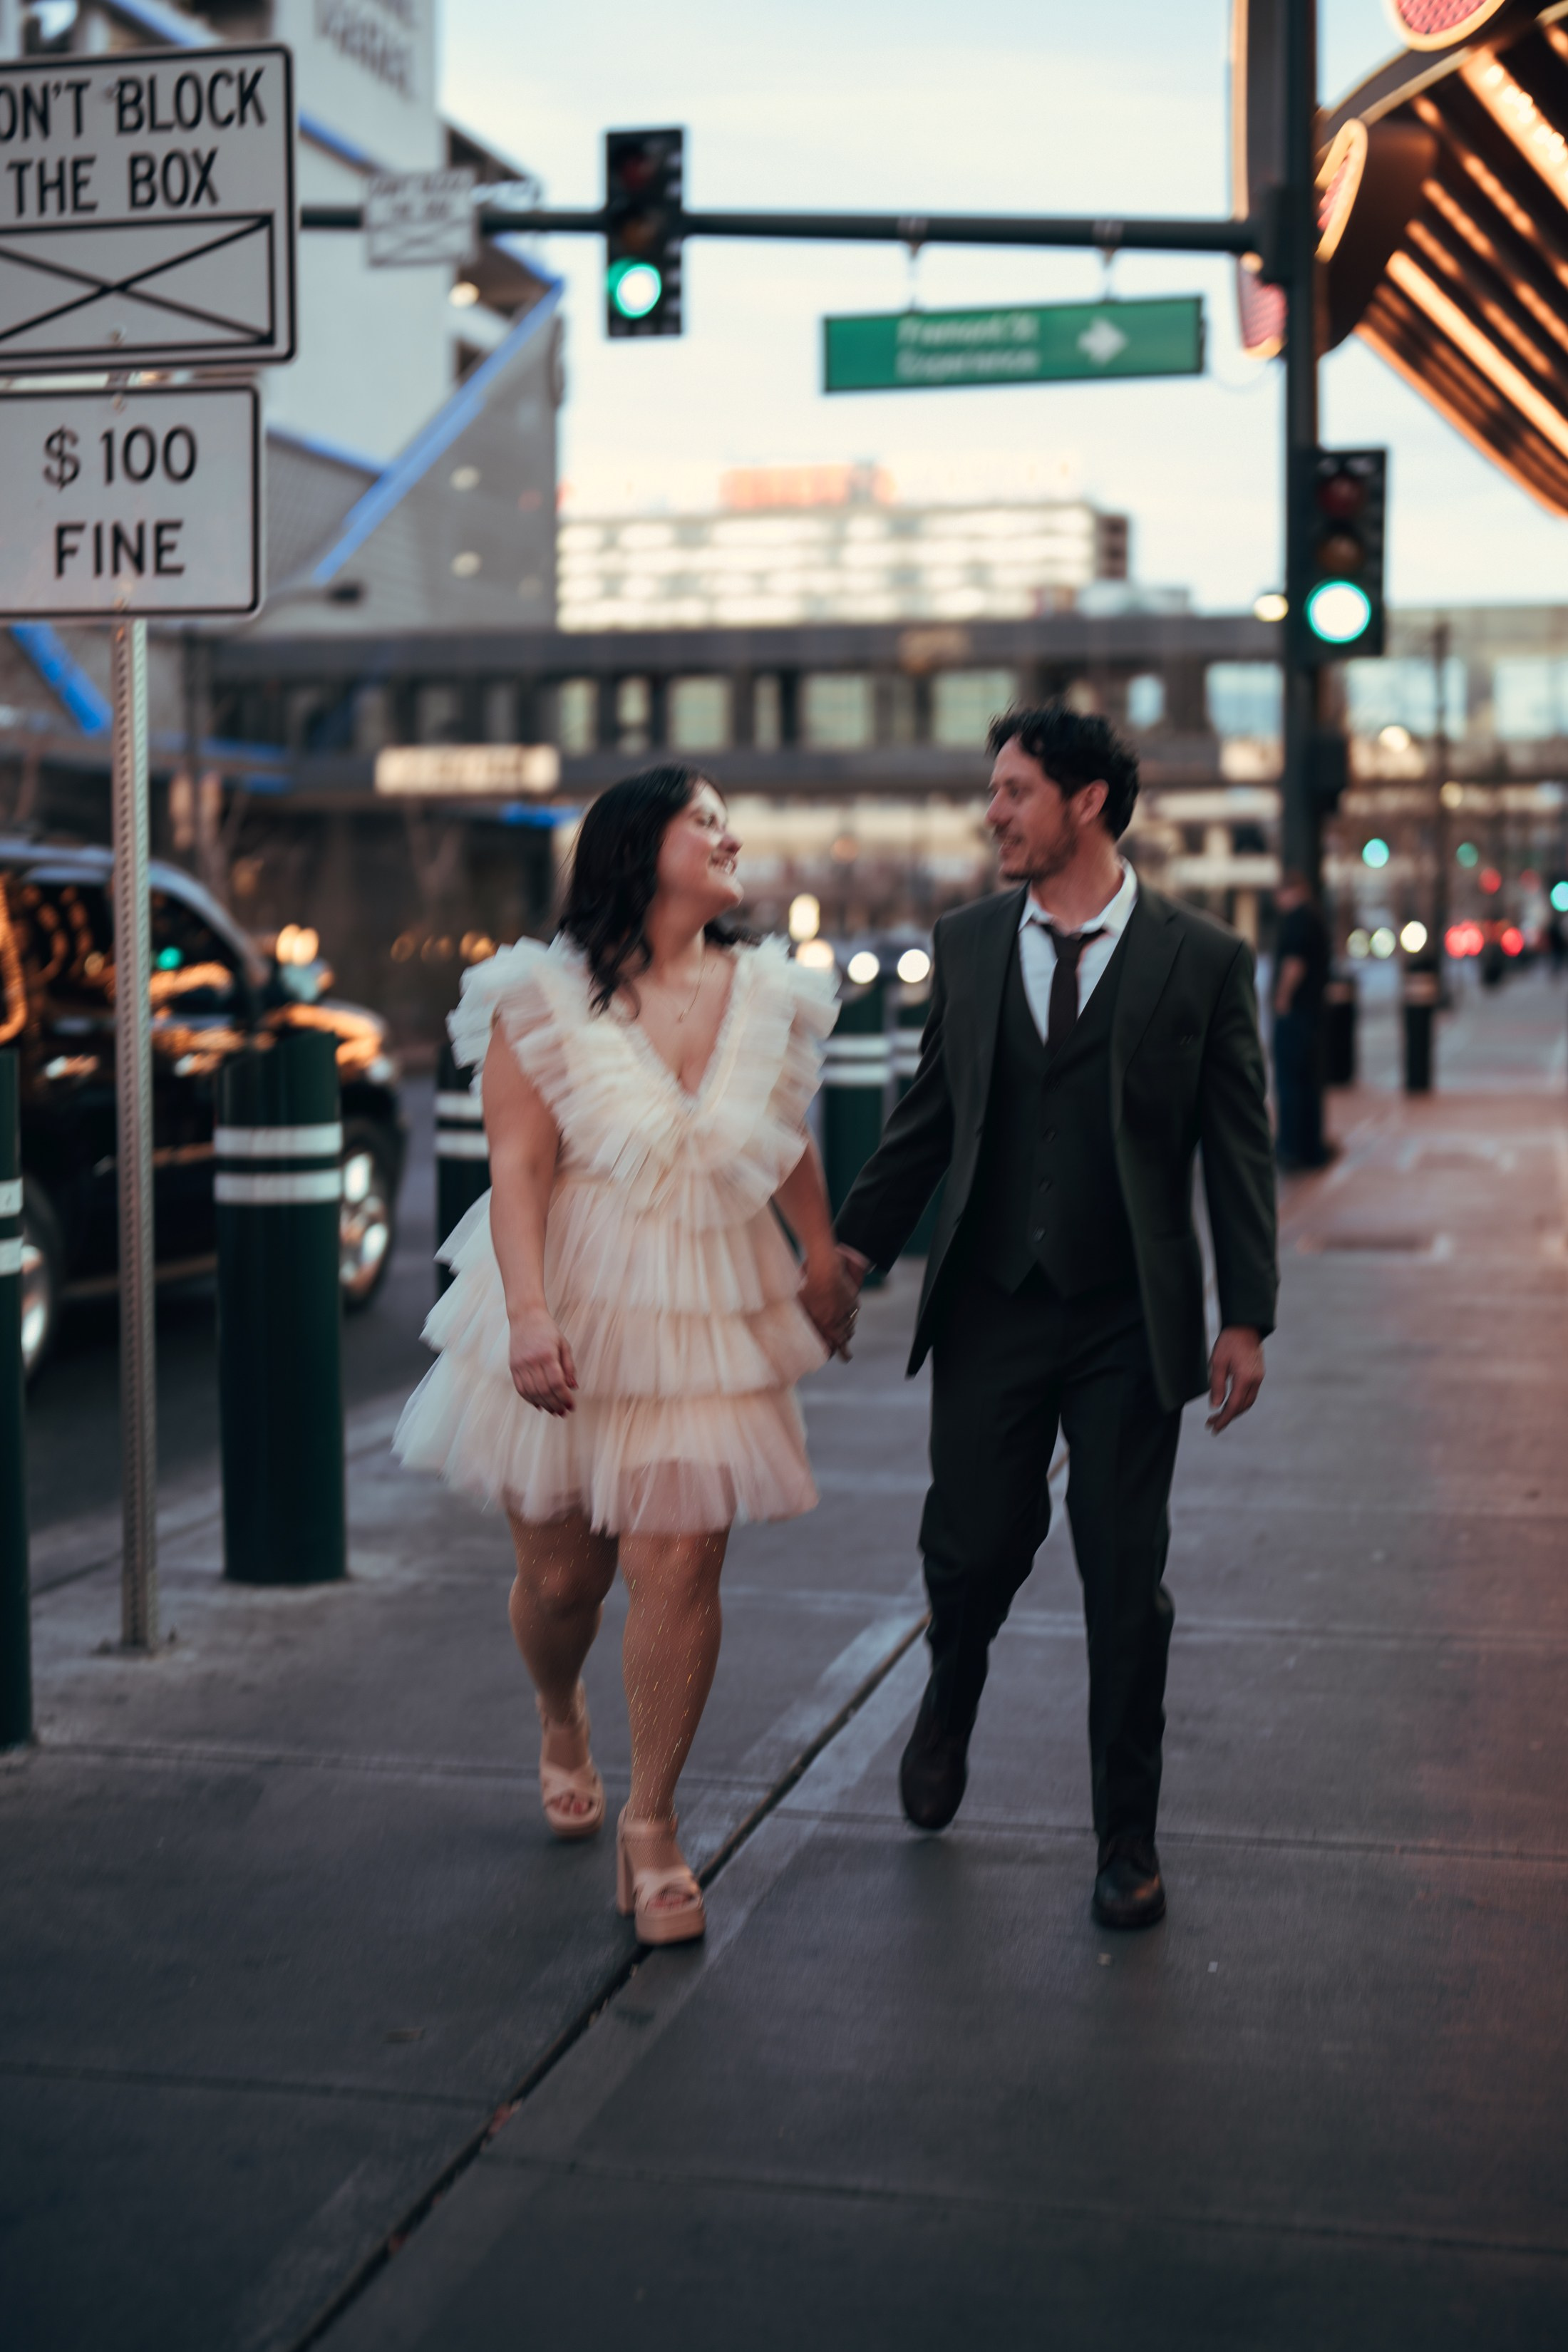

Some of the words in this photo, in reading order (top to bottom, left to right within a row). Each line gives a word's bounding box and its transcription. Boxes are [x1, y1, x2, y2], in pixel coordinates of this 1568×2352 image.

[0, 77, 92, 143] ON'T
[115, 66, 267, 137] BLOCK
[6, 154, 98, 217] THE
[128, 146, 220, 211] BOX
[55, 518, 185, 580] FINE
